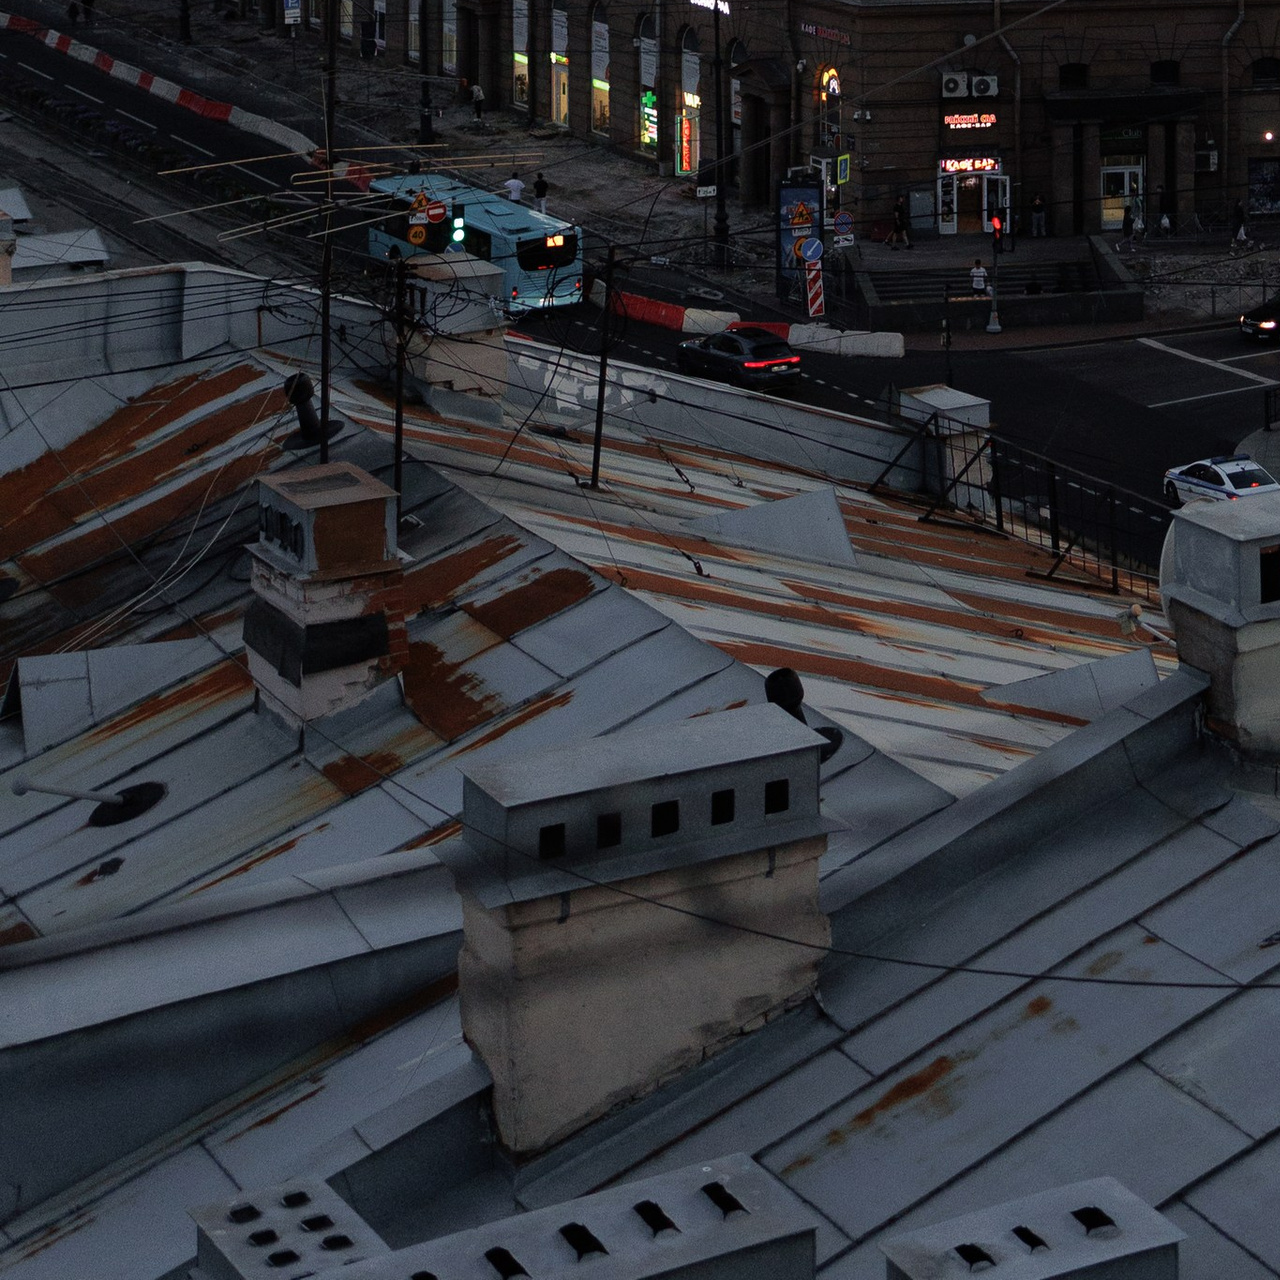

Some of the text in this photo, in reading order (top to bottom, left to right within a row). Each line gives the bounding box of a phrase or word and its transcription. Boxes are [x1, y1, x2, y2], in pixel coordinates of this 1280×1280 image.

[946, 158, 995, 171] КАФЕ БАР
[412, 230, 424, 240] 40
